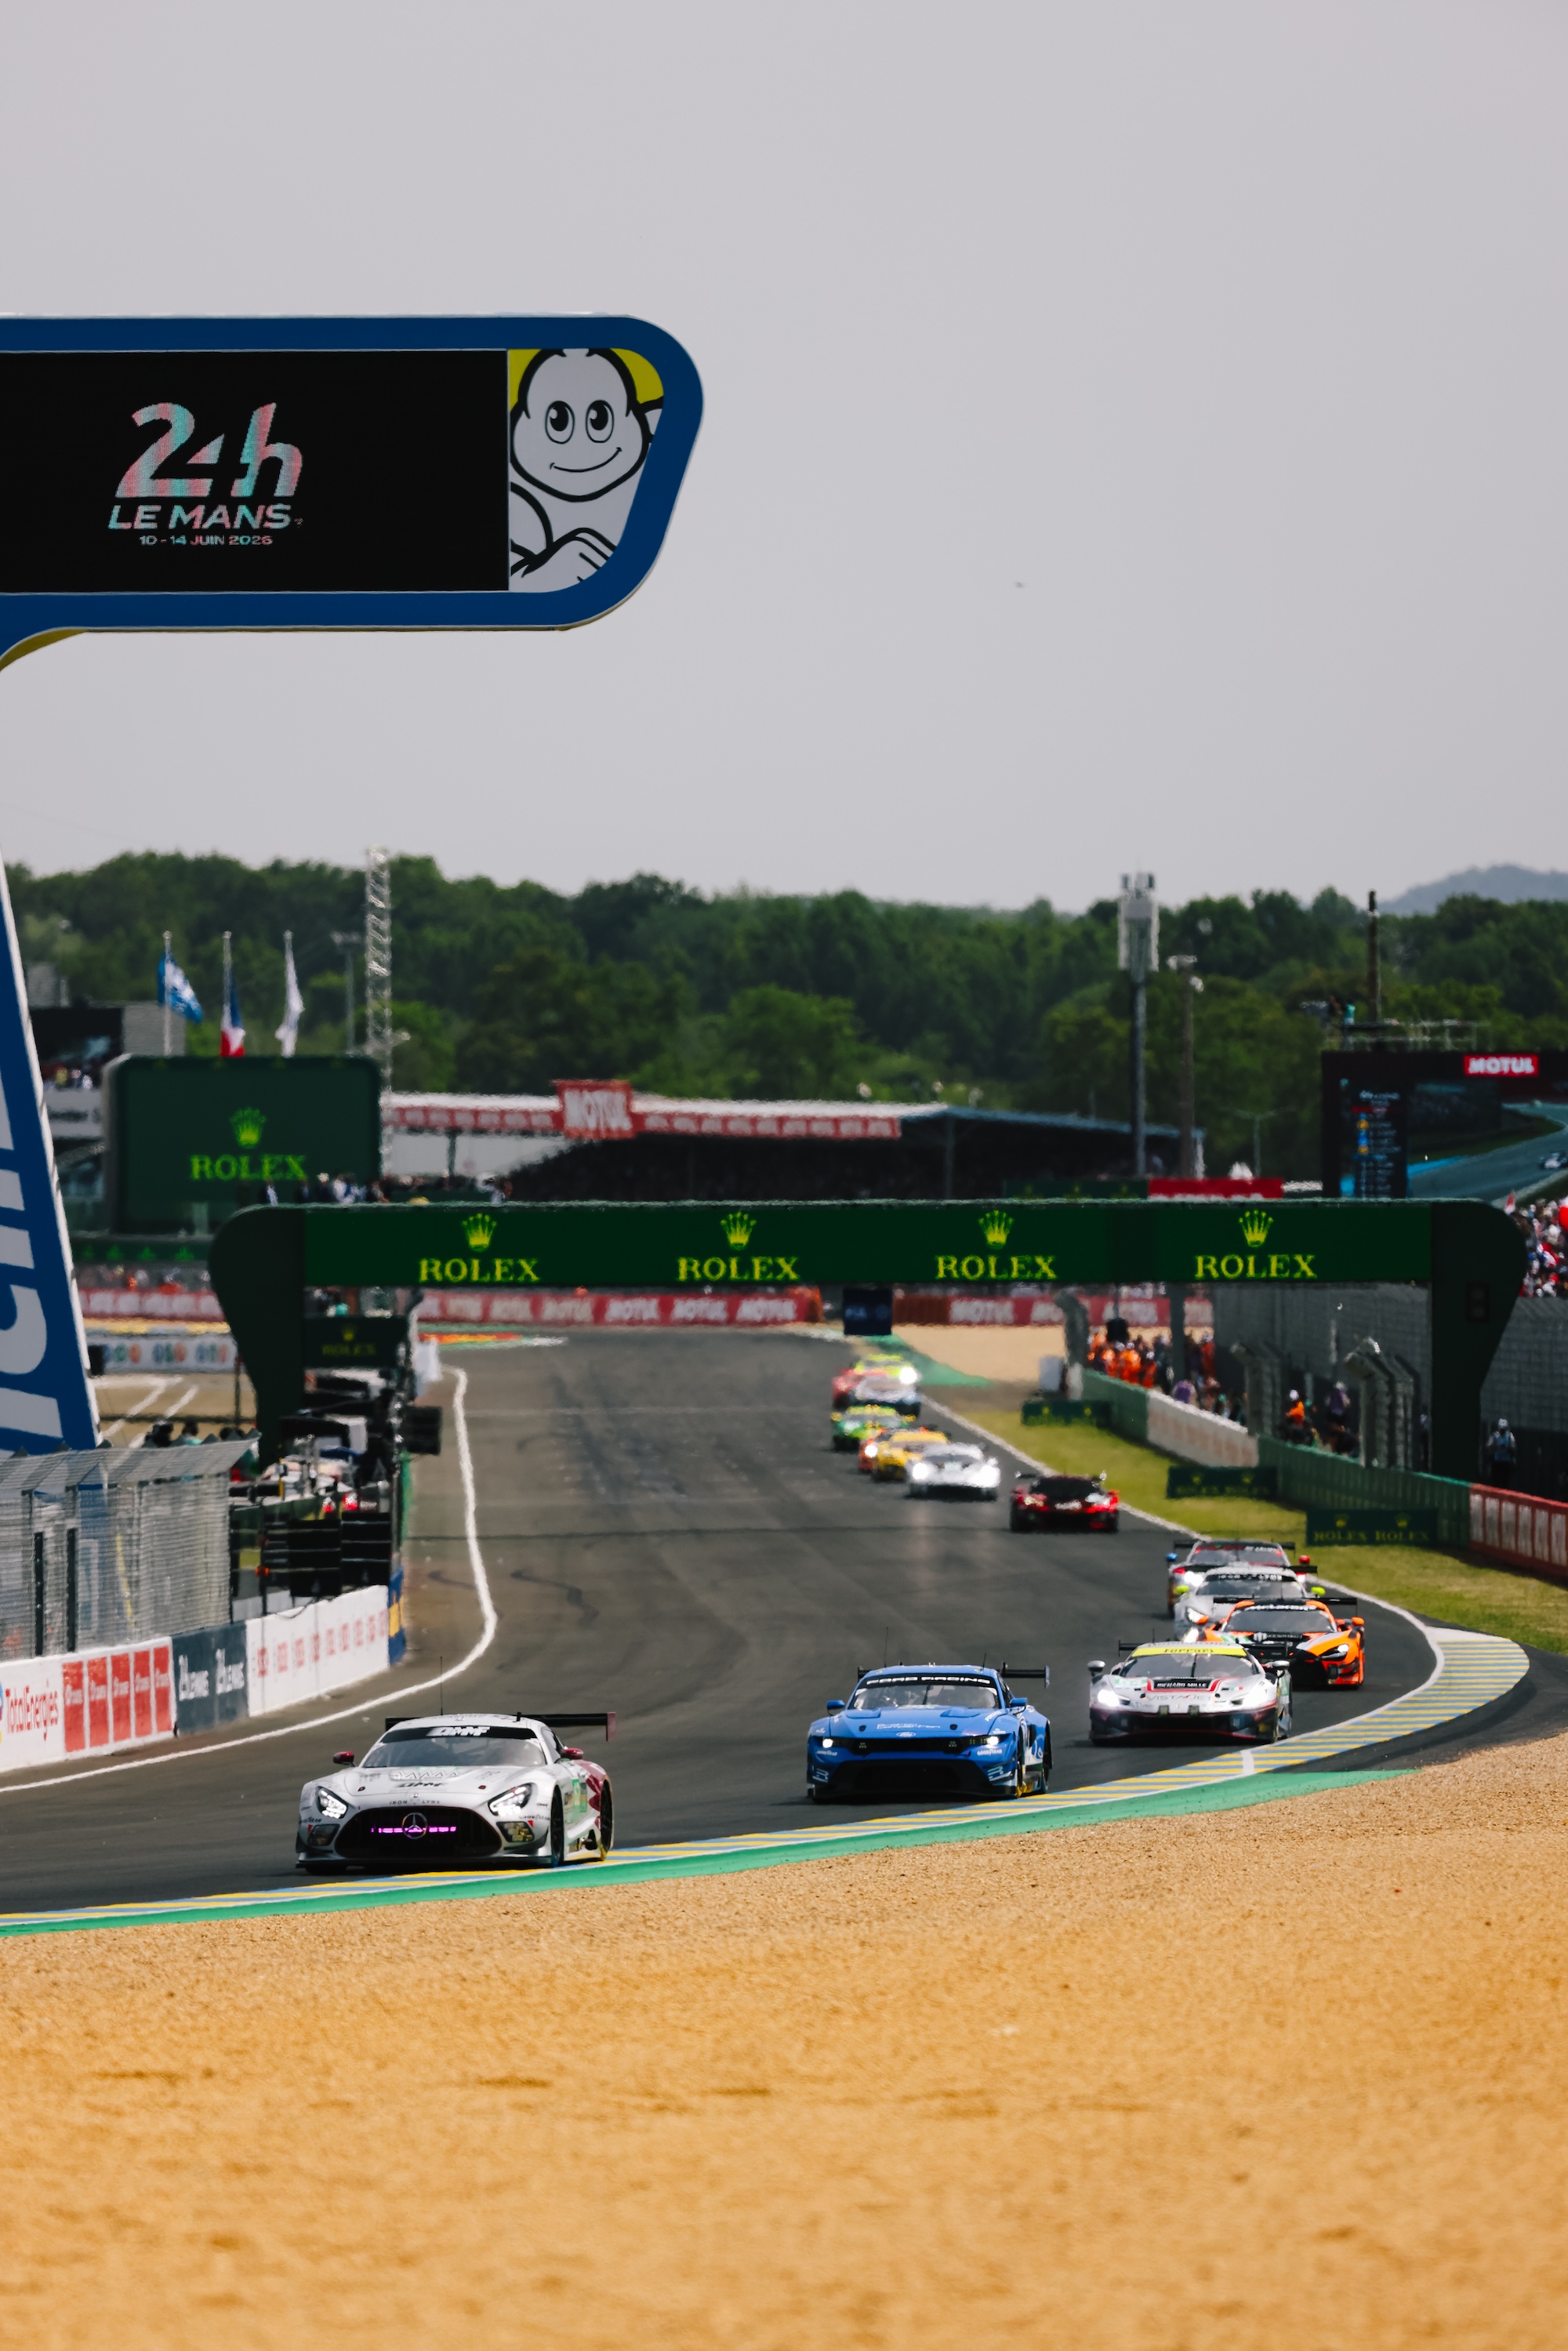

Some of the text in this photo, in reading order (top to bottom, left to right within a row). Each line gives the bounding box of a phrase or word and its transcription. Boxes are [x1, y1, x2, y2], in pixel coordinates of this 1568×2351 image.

[108, 503, 291, 529] LE MANS
[139, 535, 158, 545] 10
[169, 535, 187, 545] 14
[190, 535, 225, 545] JUIN
[1468, 1058, 1534, 1074] MOTUL
[191, 1156, 307, 1180] ROLEX
[419, 1258, 539, 1282] ROLEX
[677, 1257, 798, 1281] ROLEX
[936, 1255, 1058, 1280] ROLEX
[1195, 1254, 1316, 1279] ROLEX
[1314, 1530, 1430, 1541] ROLEX ROLEX
